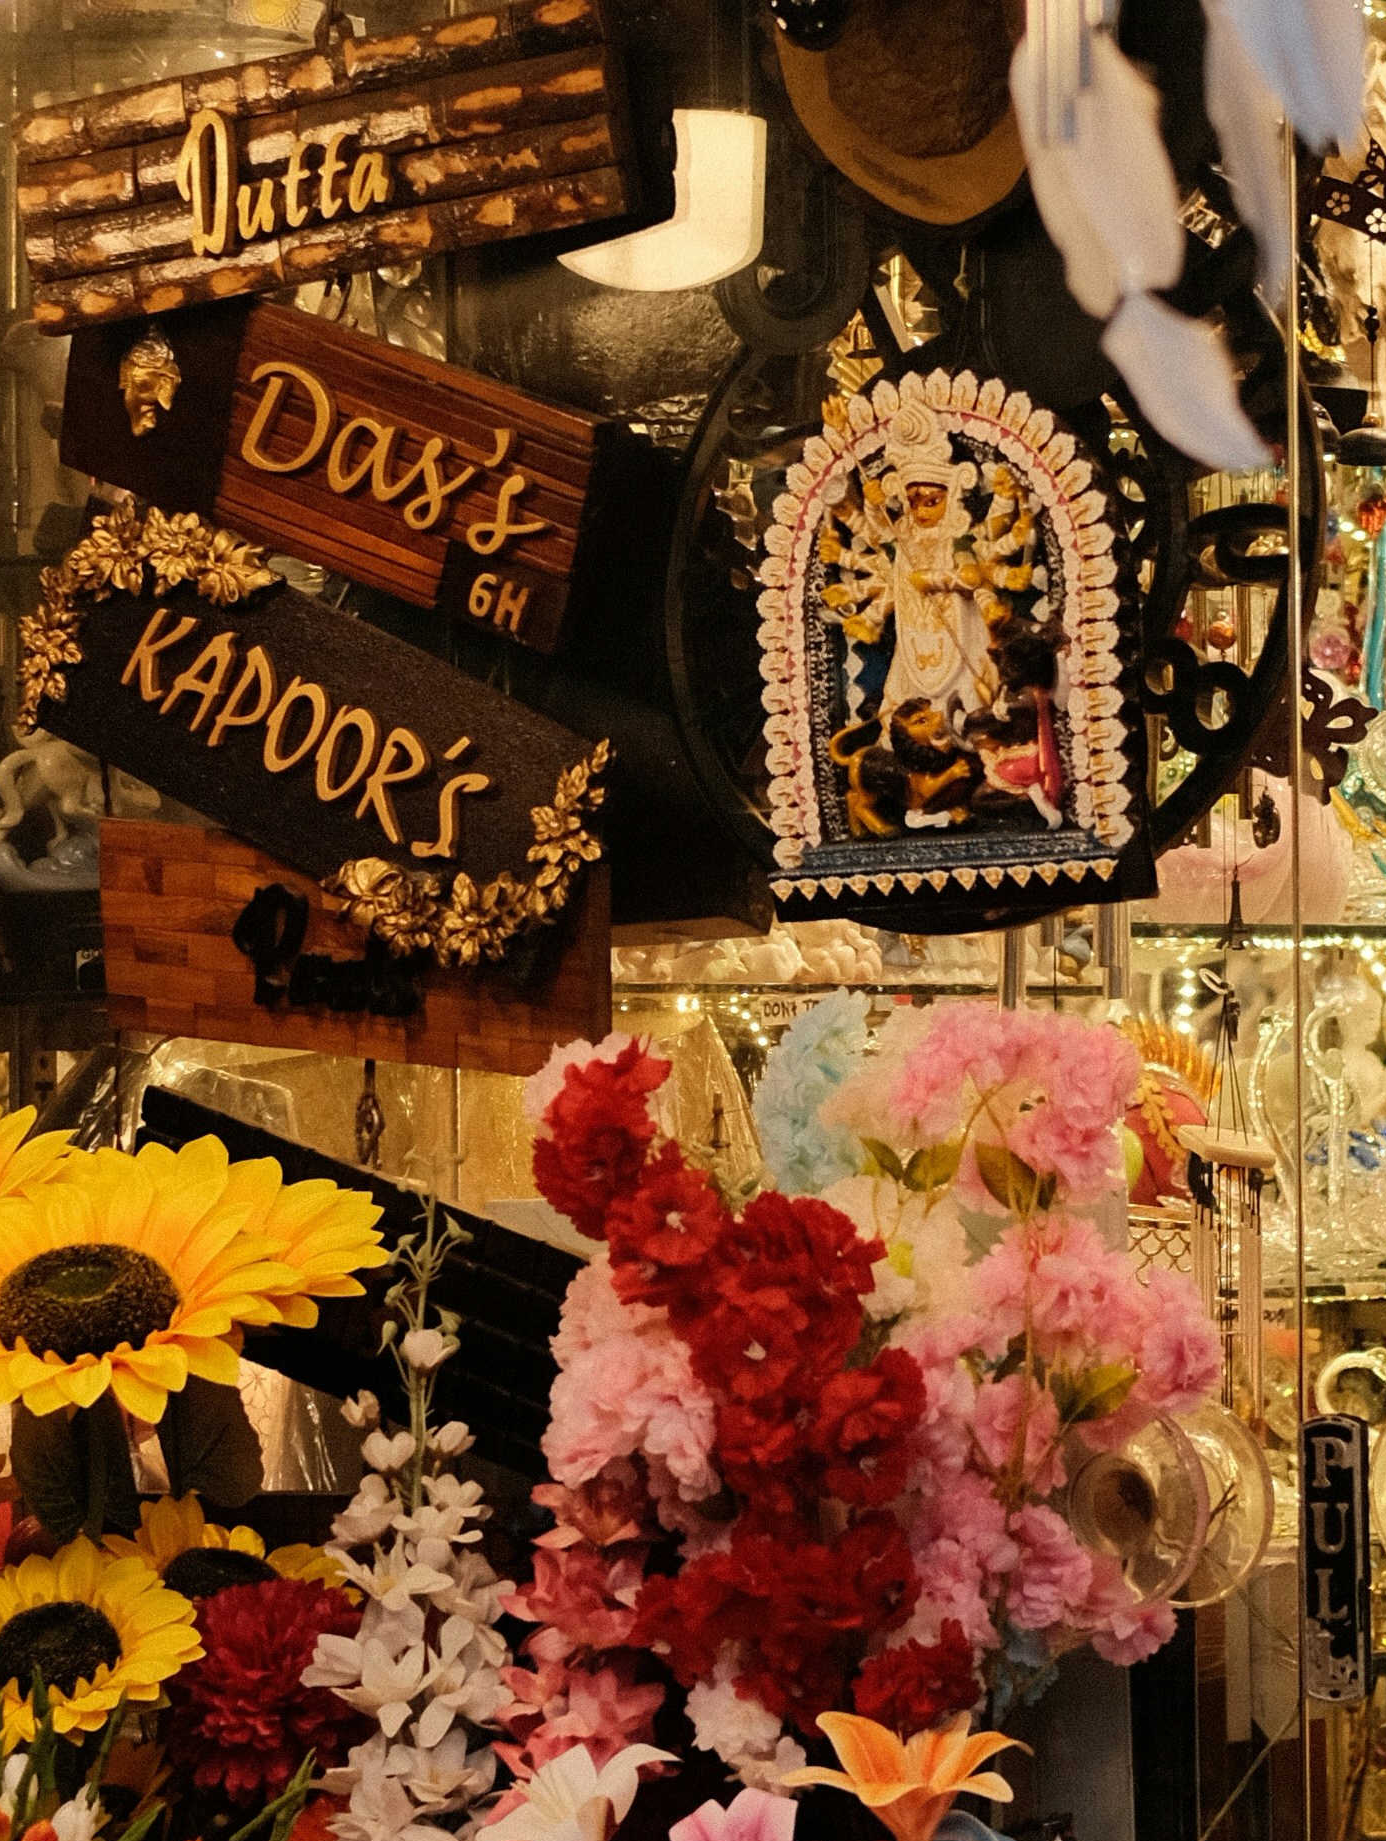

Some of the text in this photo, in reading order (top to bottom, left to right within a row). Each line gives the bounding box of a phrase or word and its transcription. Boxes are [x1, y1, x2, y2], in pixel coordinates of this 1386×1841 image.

[174, 108, 394, 258] Dutta
[240, 361, 553, 556] Das's
[121, 607, 490, 860] KAPOOR'S
